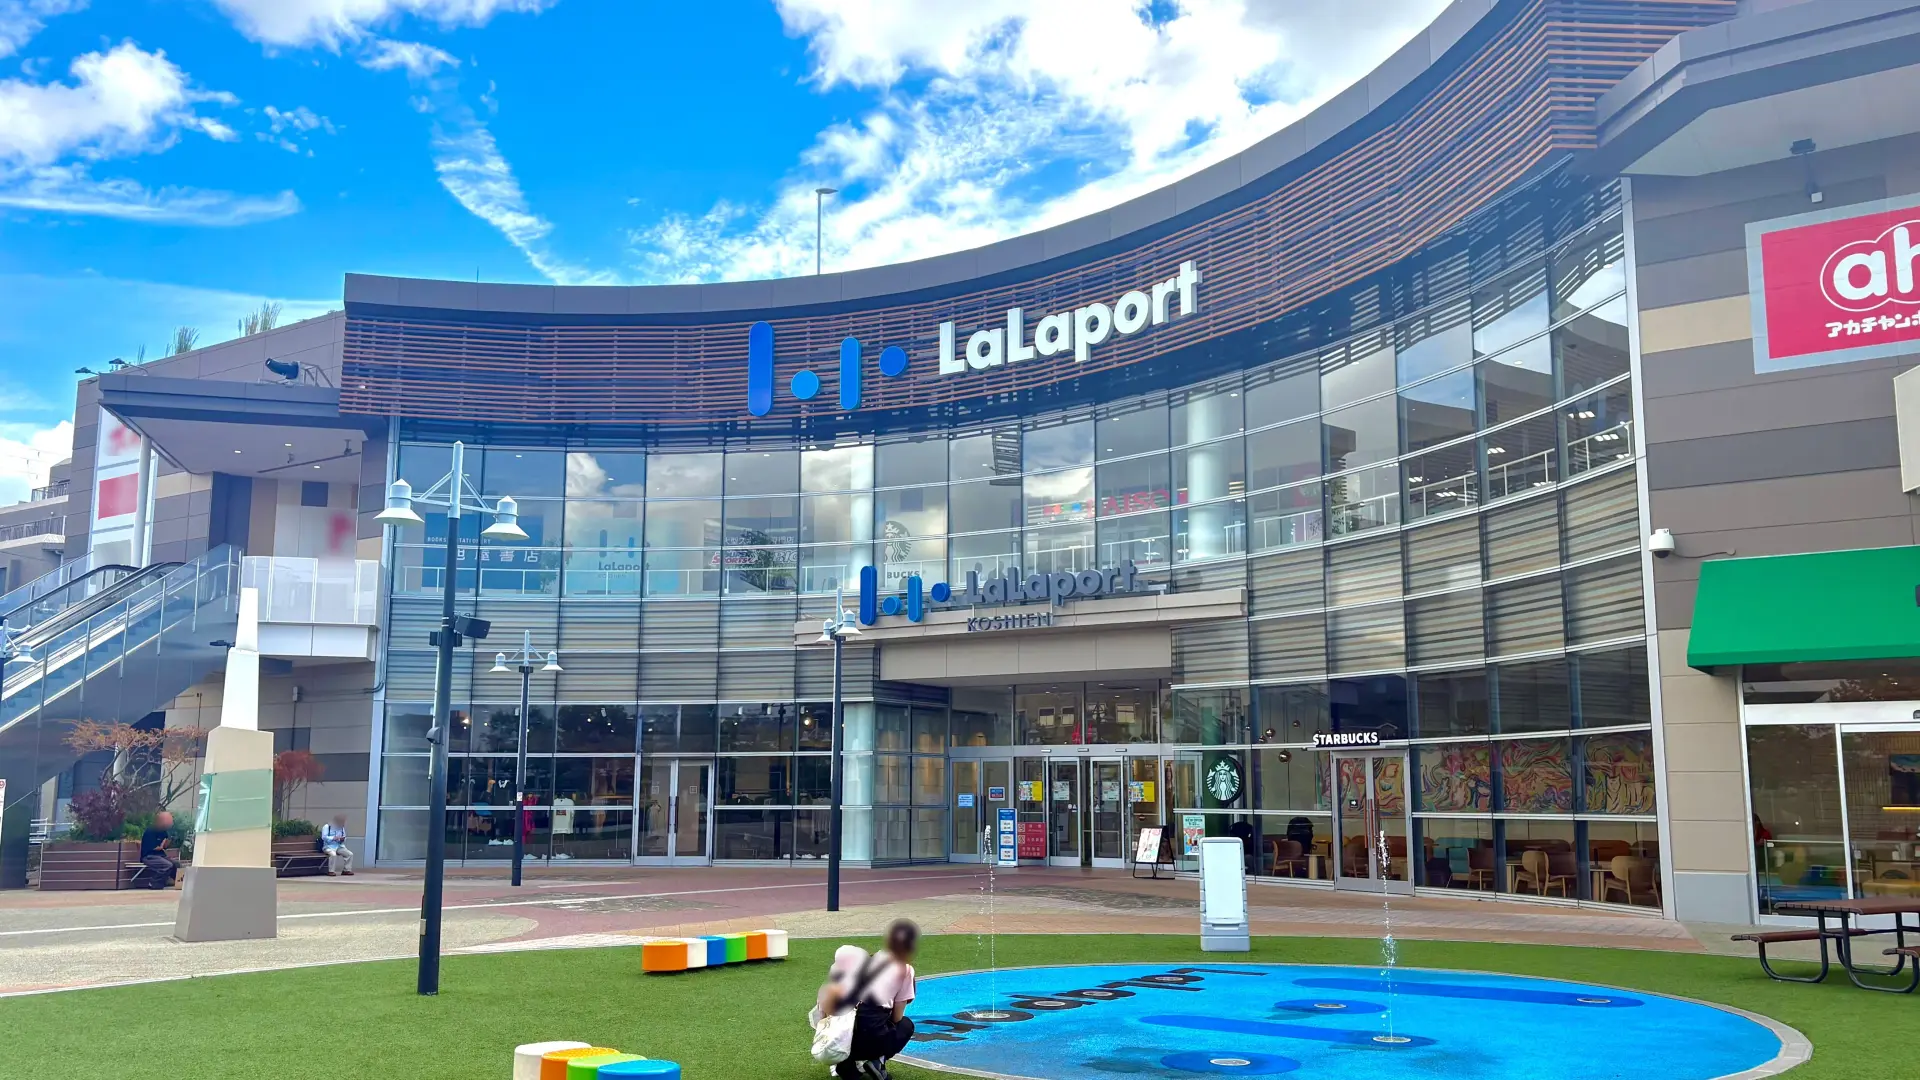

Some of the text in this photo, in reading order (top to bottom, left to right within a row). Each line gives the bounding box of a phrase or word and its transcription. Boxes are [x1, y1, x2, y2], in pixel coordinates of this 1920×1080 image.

[939, 260, 1203, 376] LaLaport
[598, 561, 650, 573] LaLapot
[966, 558, 1138, 607] LaLaport
[967, 611, 1054, 632] KOSHIEN
[1312, 732, 1378, 746] STARBUCKS
